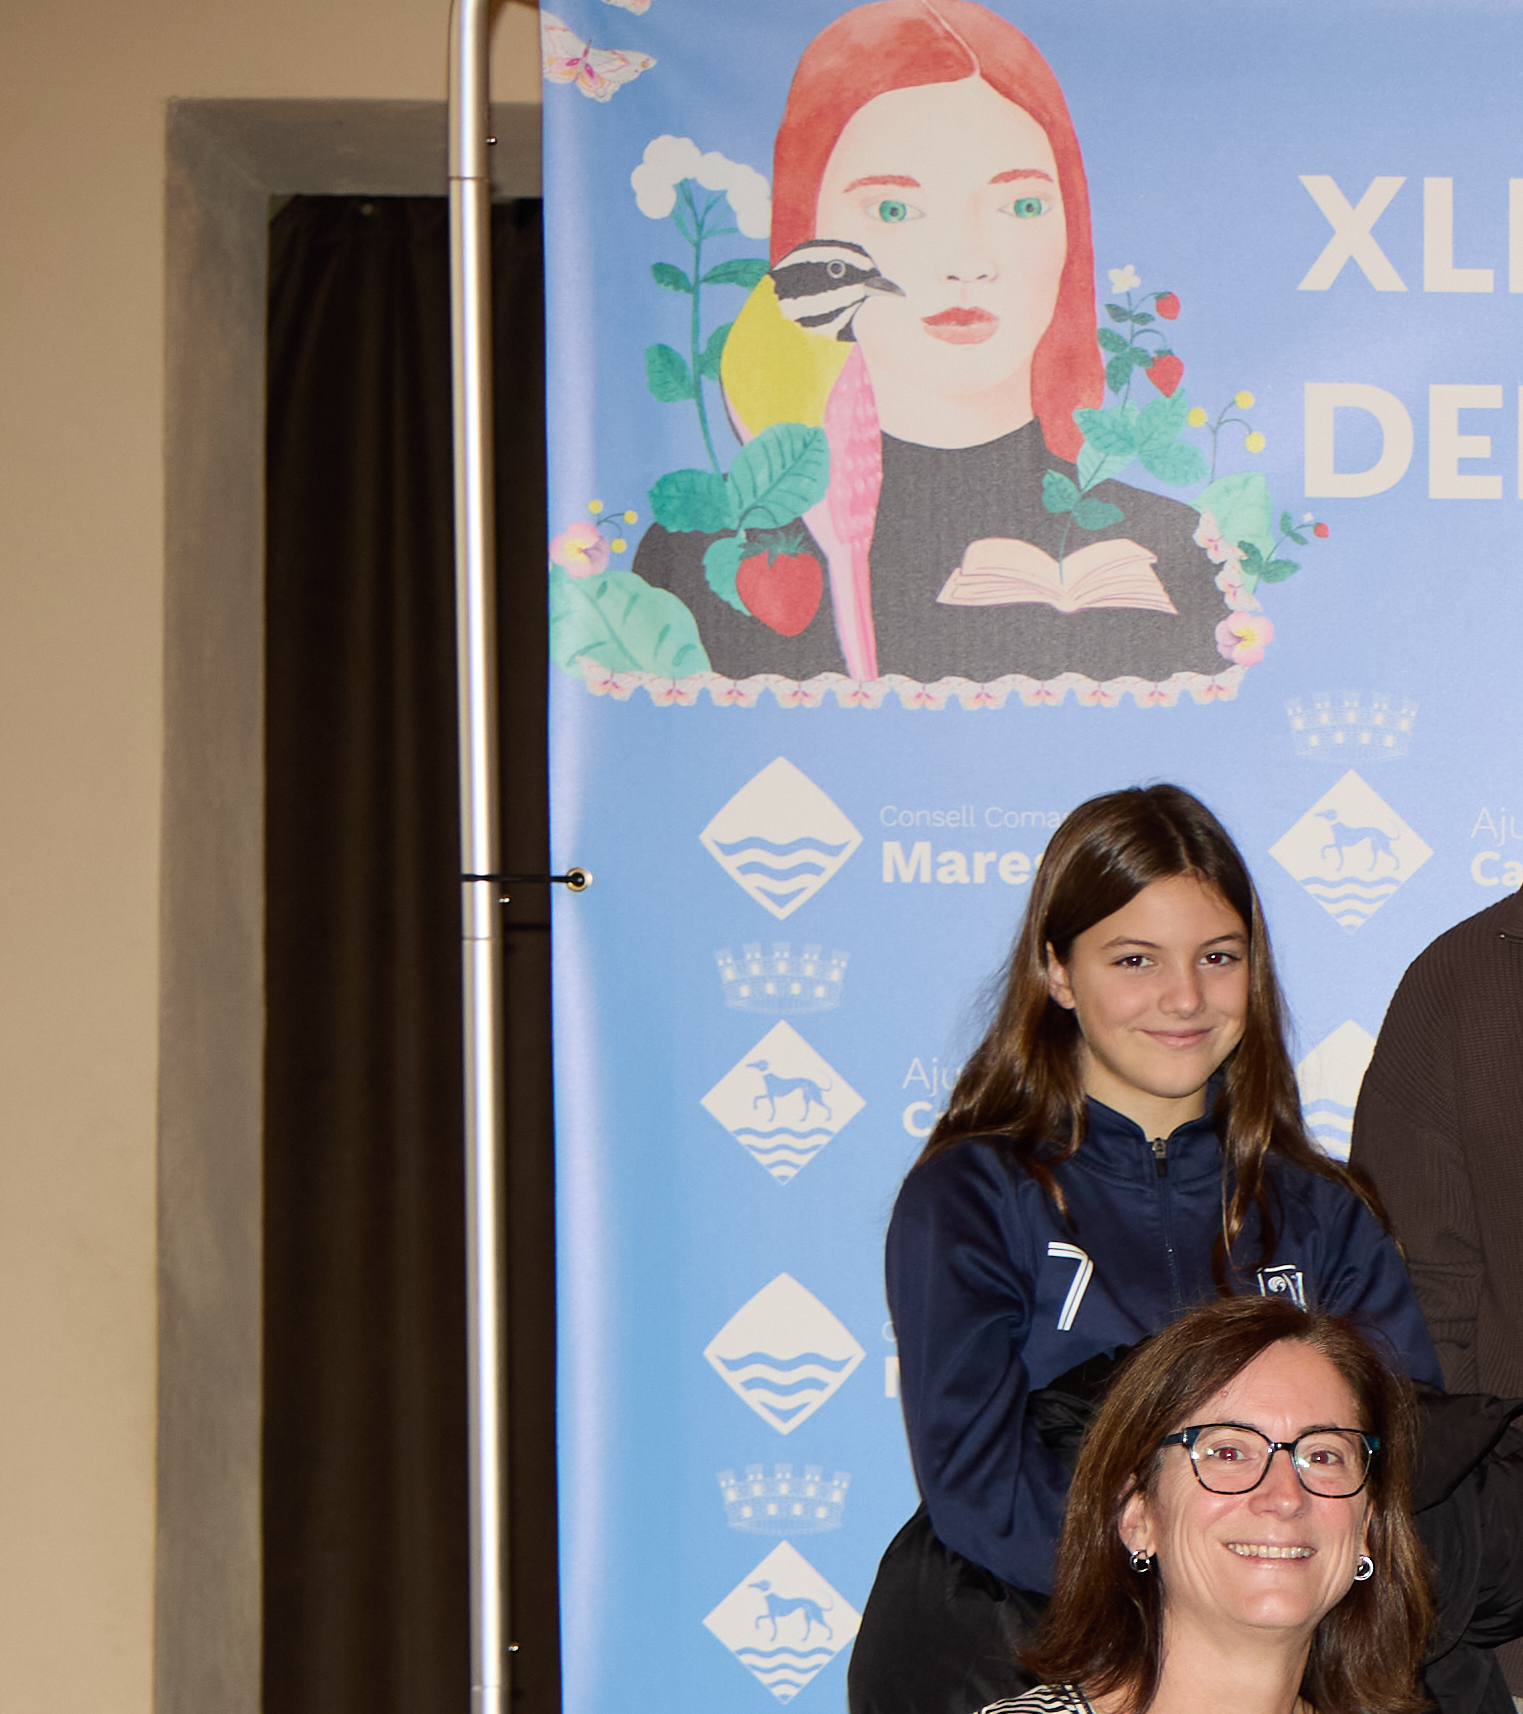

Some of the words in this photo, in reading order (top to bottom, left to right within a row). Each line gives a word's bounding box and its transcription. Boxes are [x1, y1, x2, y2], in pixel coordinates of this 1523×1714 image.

[879, 804, 977, 828] Consell
[983, 800, 1068, 834] Coma
[880, 838, 1044, 888] Mare
[1047, 1241, 1096, 1332] 7
